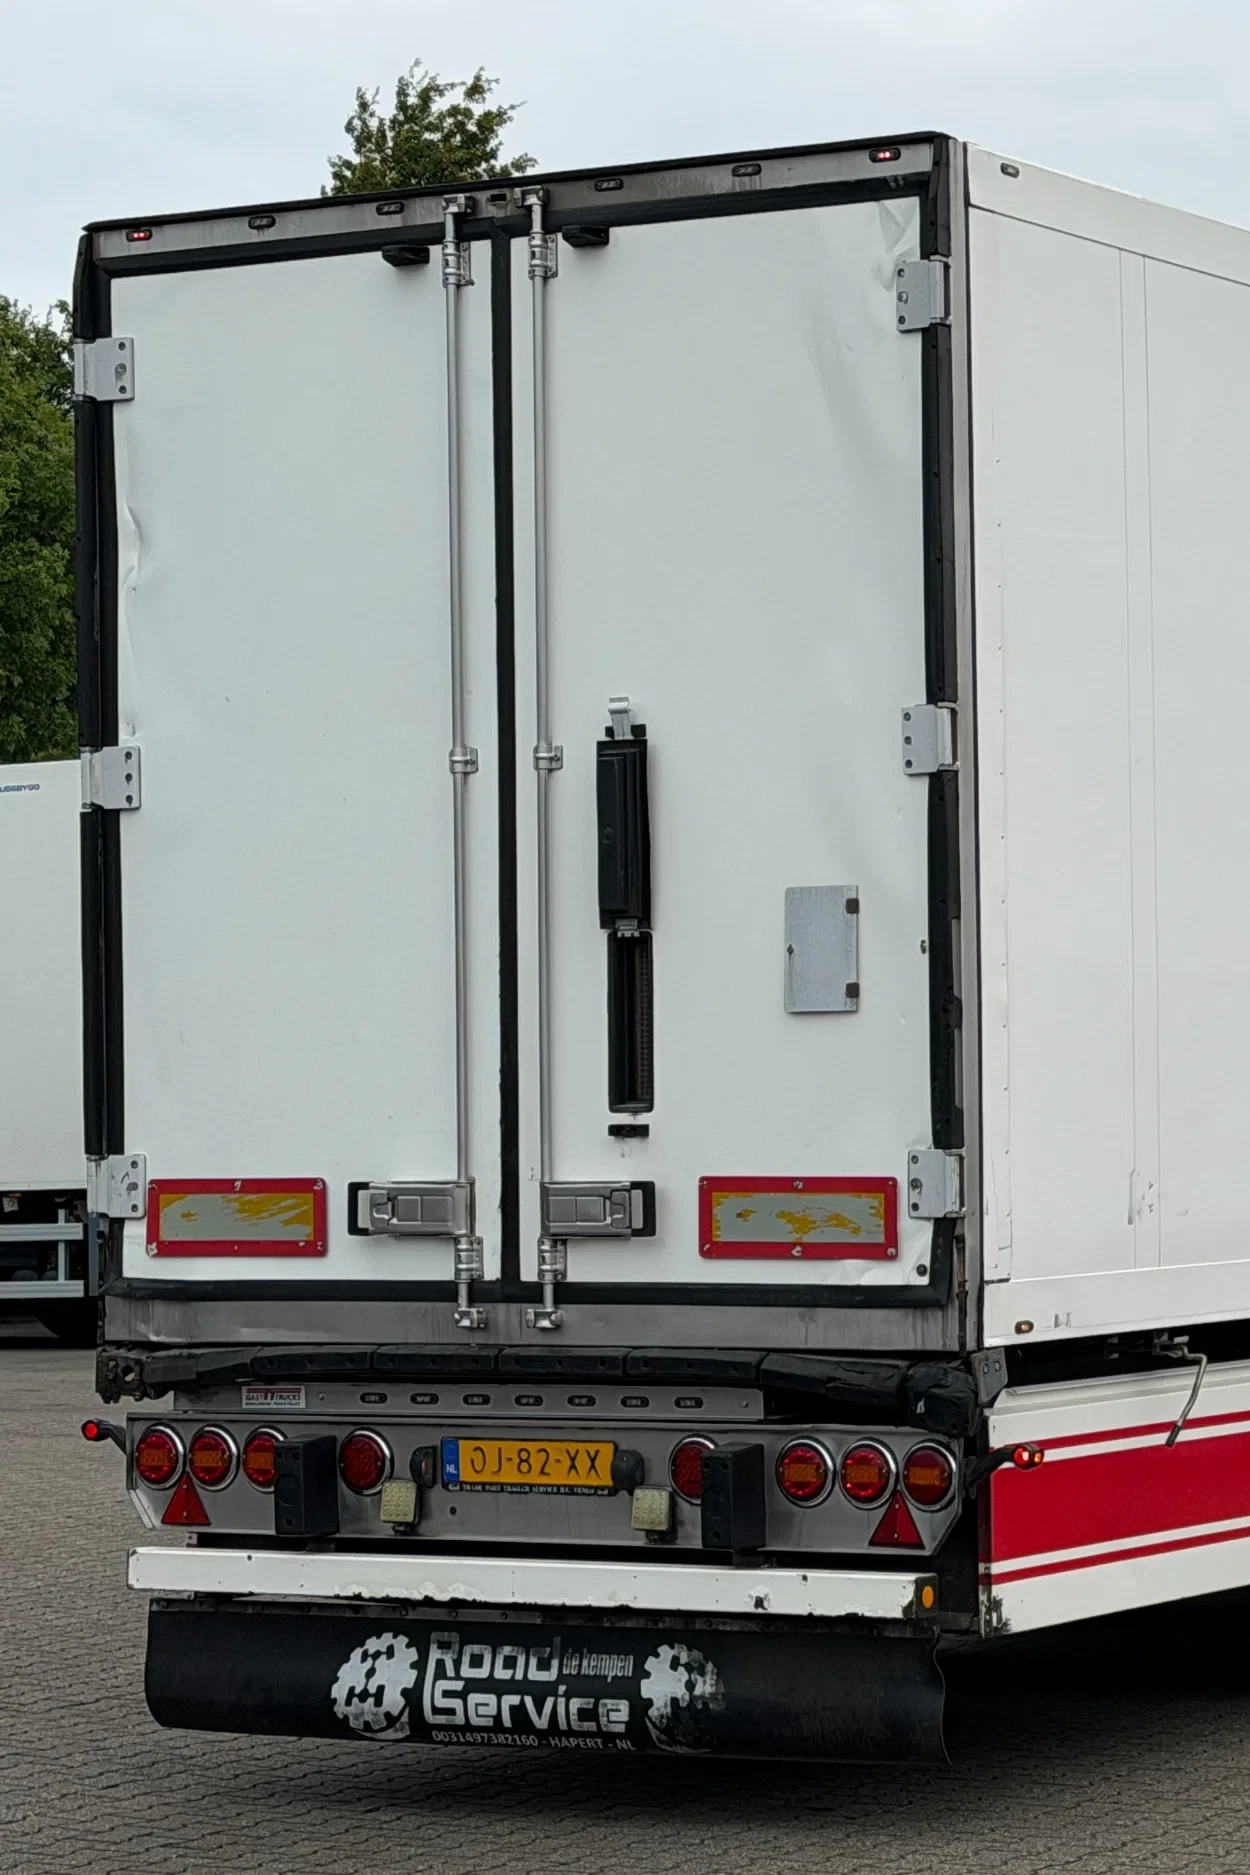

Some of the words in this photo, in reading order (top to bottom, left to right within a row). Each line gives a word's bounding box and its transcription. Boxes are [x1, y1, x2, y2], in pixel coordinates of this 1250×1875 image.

[446, 1464, 458, 1474] NL
[425, 1632, 561, 1682] Road
[562, 1648, 579, 1676] de
[581, 1649, 634, 1683] kempen
[424, 1680, 630, 1733] Service
[432, 1730, 539, 1747] 0031497382160
[550, 1735, 604, 1750] HAPERT
[615, 1739, 637, 1751] NL
